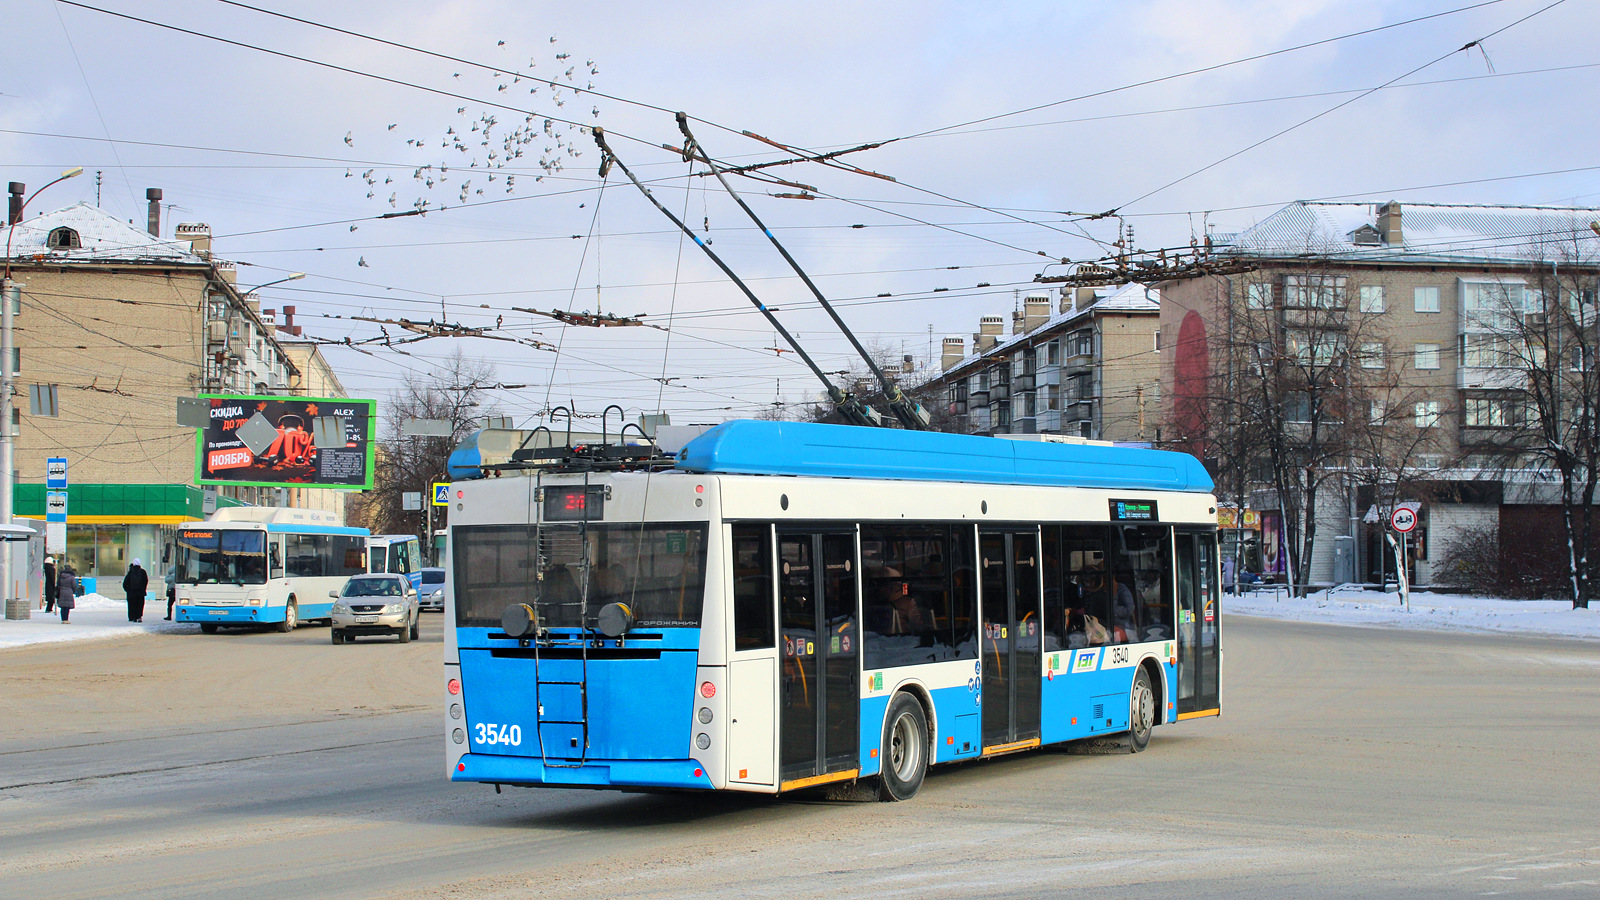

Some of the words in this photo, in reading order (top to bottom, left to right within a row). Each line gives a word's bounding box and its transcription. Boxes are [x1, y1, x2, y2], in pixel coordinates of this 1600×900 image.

[210, 406, 244, 418] СКИДКА
[333, 408, 354, 416] ALEX
[222, 420, 235, 431] ДО
[211, 452, 250, 466] НОЯБРЬ
[1112, 647, 1129, 664] 3540
[475, 722, 521, 746] 3540
